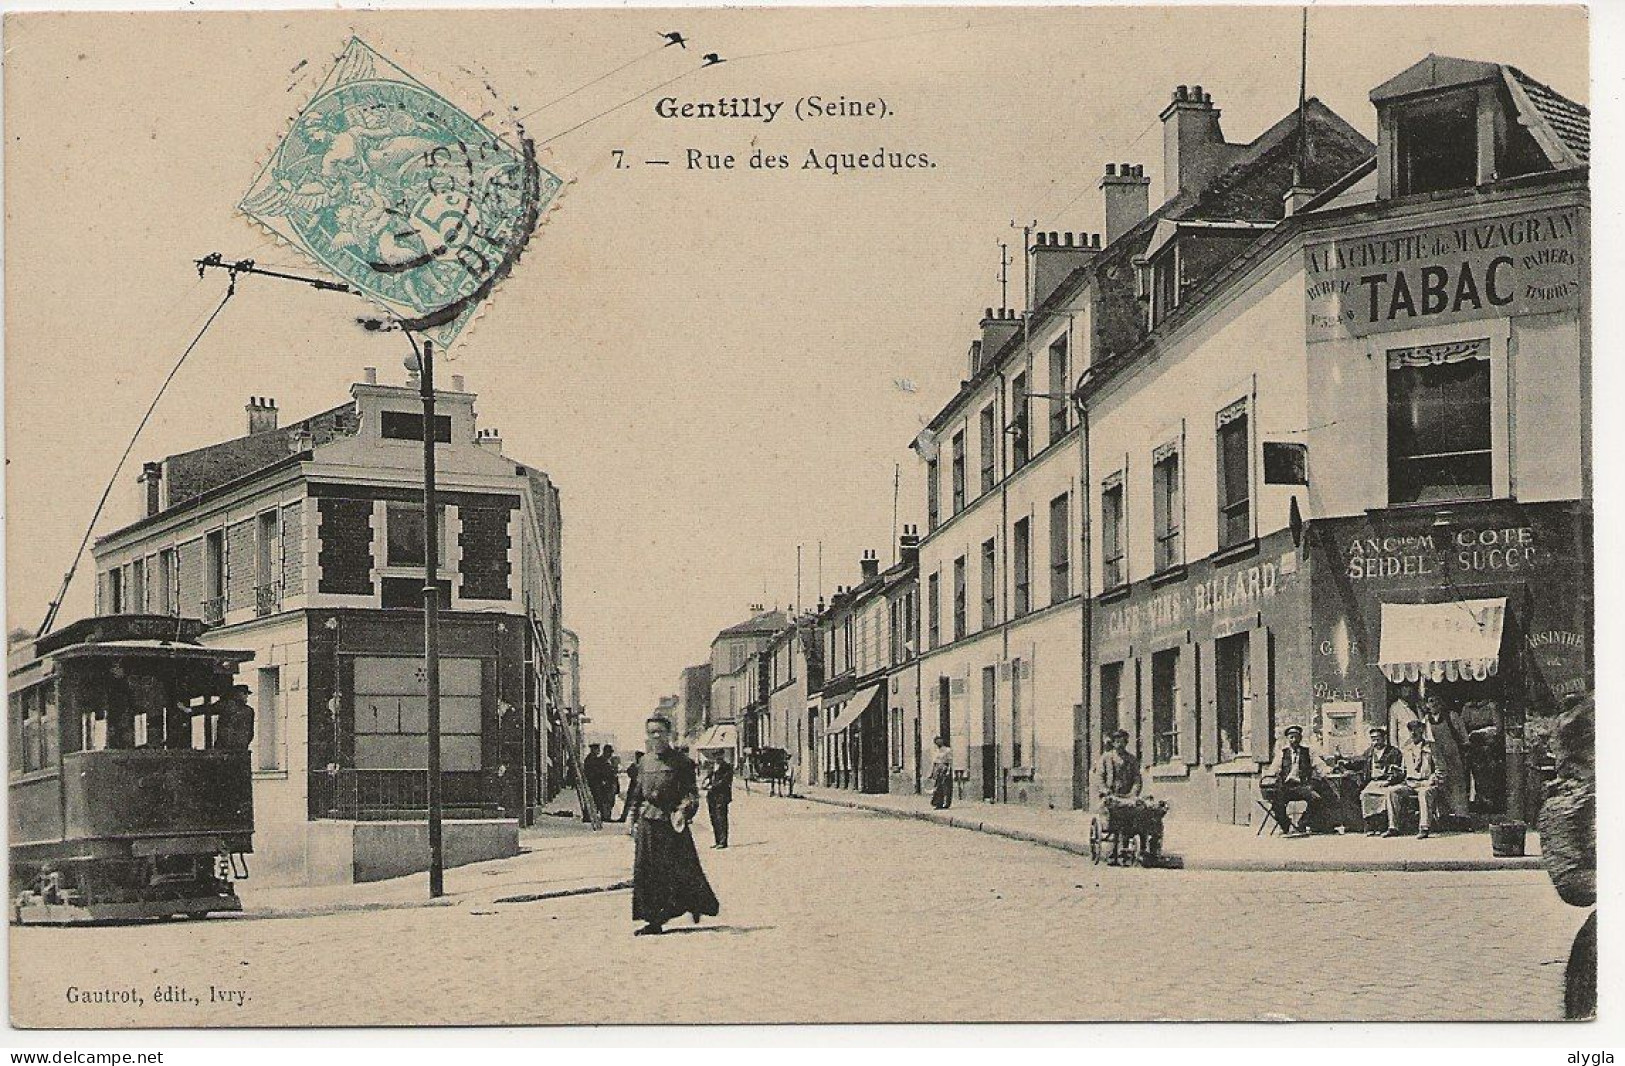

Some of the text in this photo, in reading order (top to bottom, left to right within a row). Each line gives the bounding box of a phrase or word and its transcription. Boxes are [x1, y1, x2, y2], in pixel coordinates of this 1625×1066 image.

[1360, 255, 1514, 323] TABAC
[1348, 555, 1433, 578] SEIDEL
[1195, 562, 1276, 615] BILLARD
[1525, 630, 1584, 649] ABSINTHE
